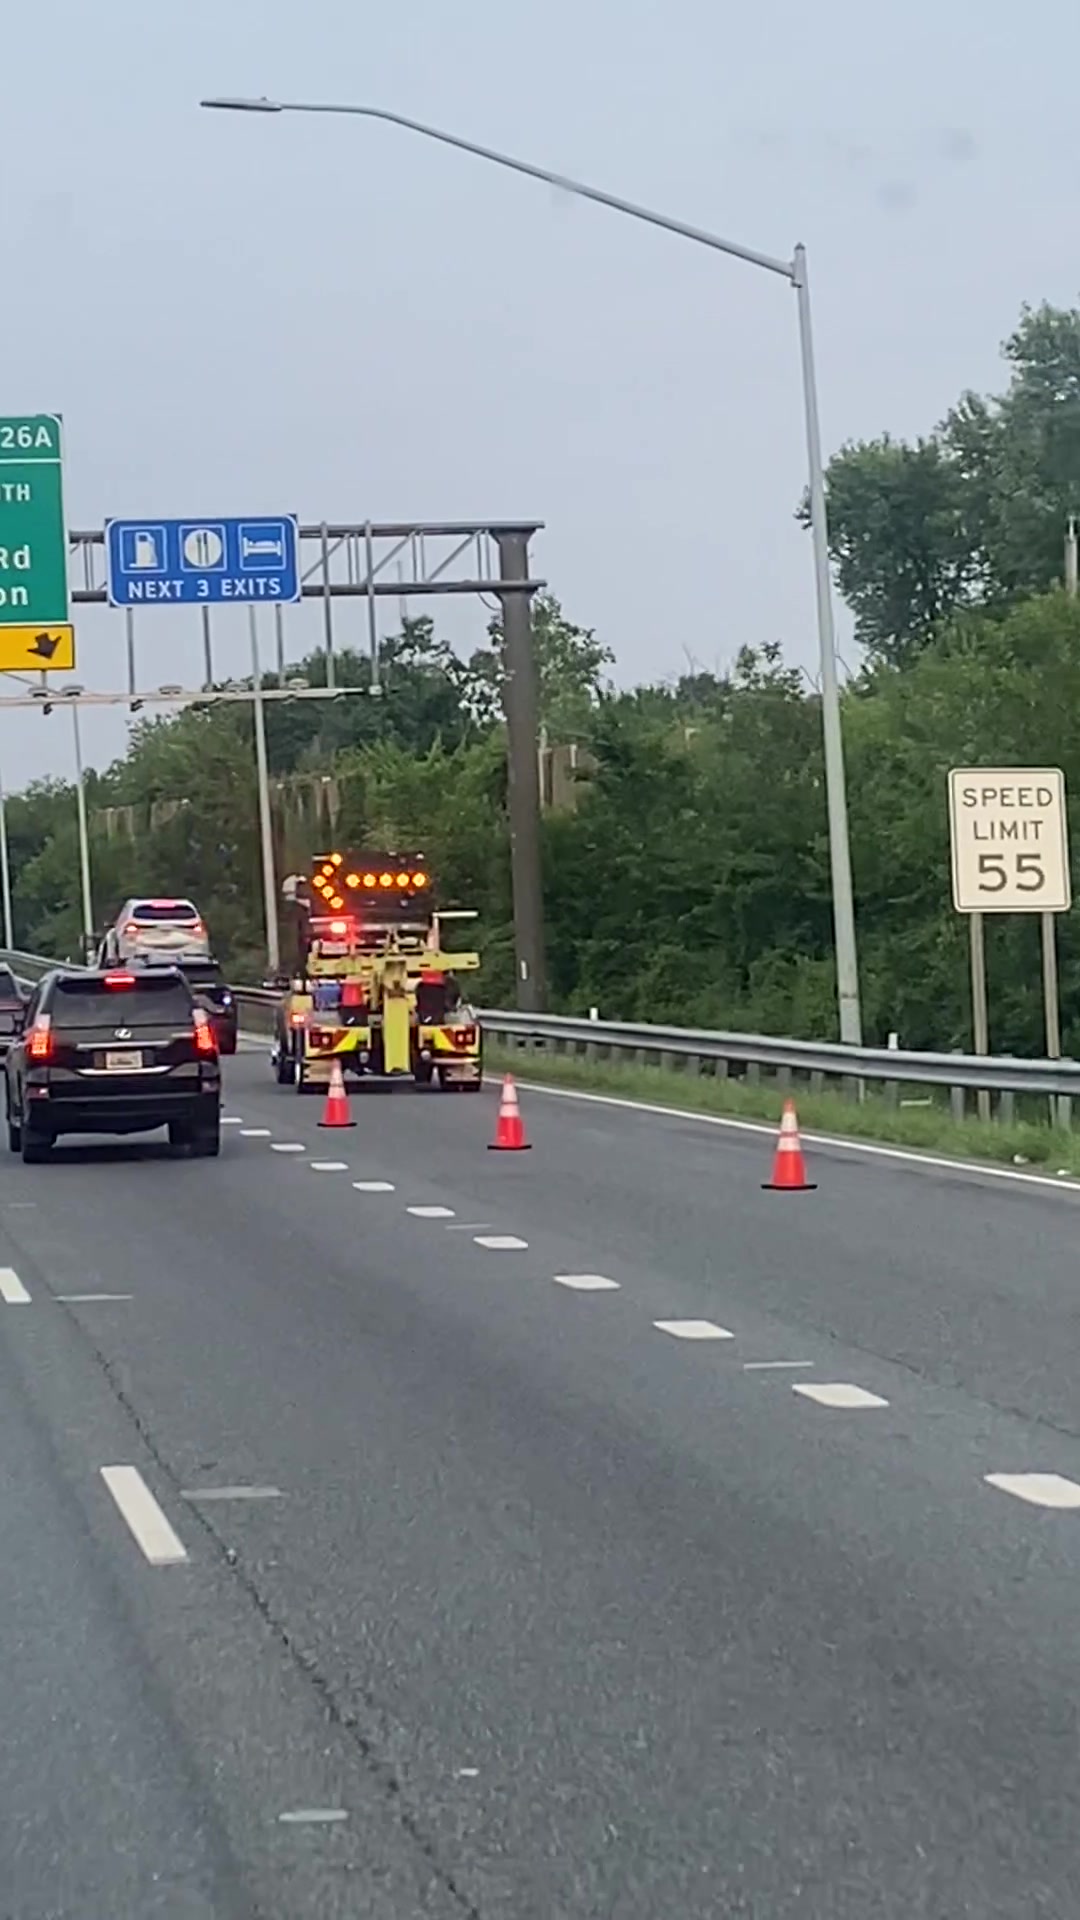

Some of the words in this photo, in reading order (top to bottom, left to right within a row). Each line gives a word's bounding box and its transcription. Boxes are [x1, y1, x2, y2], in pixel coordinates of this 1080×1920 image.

[0, 426, 52, 448] 26A
[1, 483, 31, 502] TH
[128, 580, 184, 599] NEXT
[197, 579, 209, 597] 3
[221, 577, 282, 596] EXITS
[962, 787, 1053, 808] SPEED
[973, 820, 1044, 840] LIMIT
[978, 853, 1046, 892] 55
